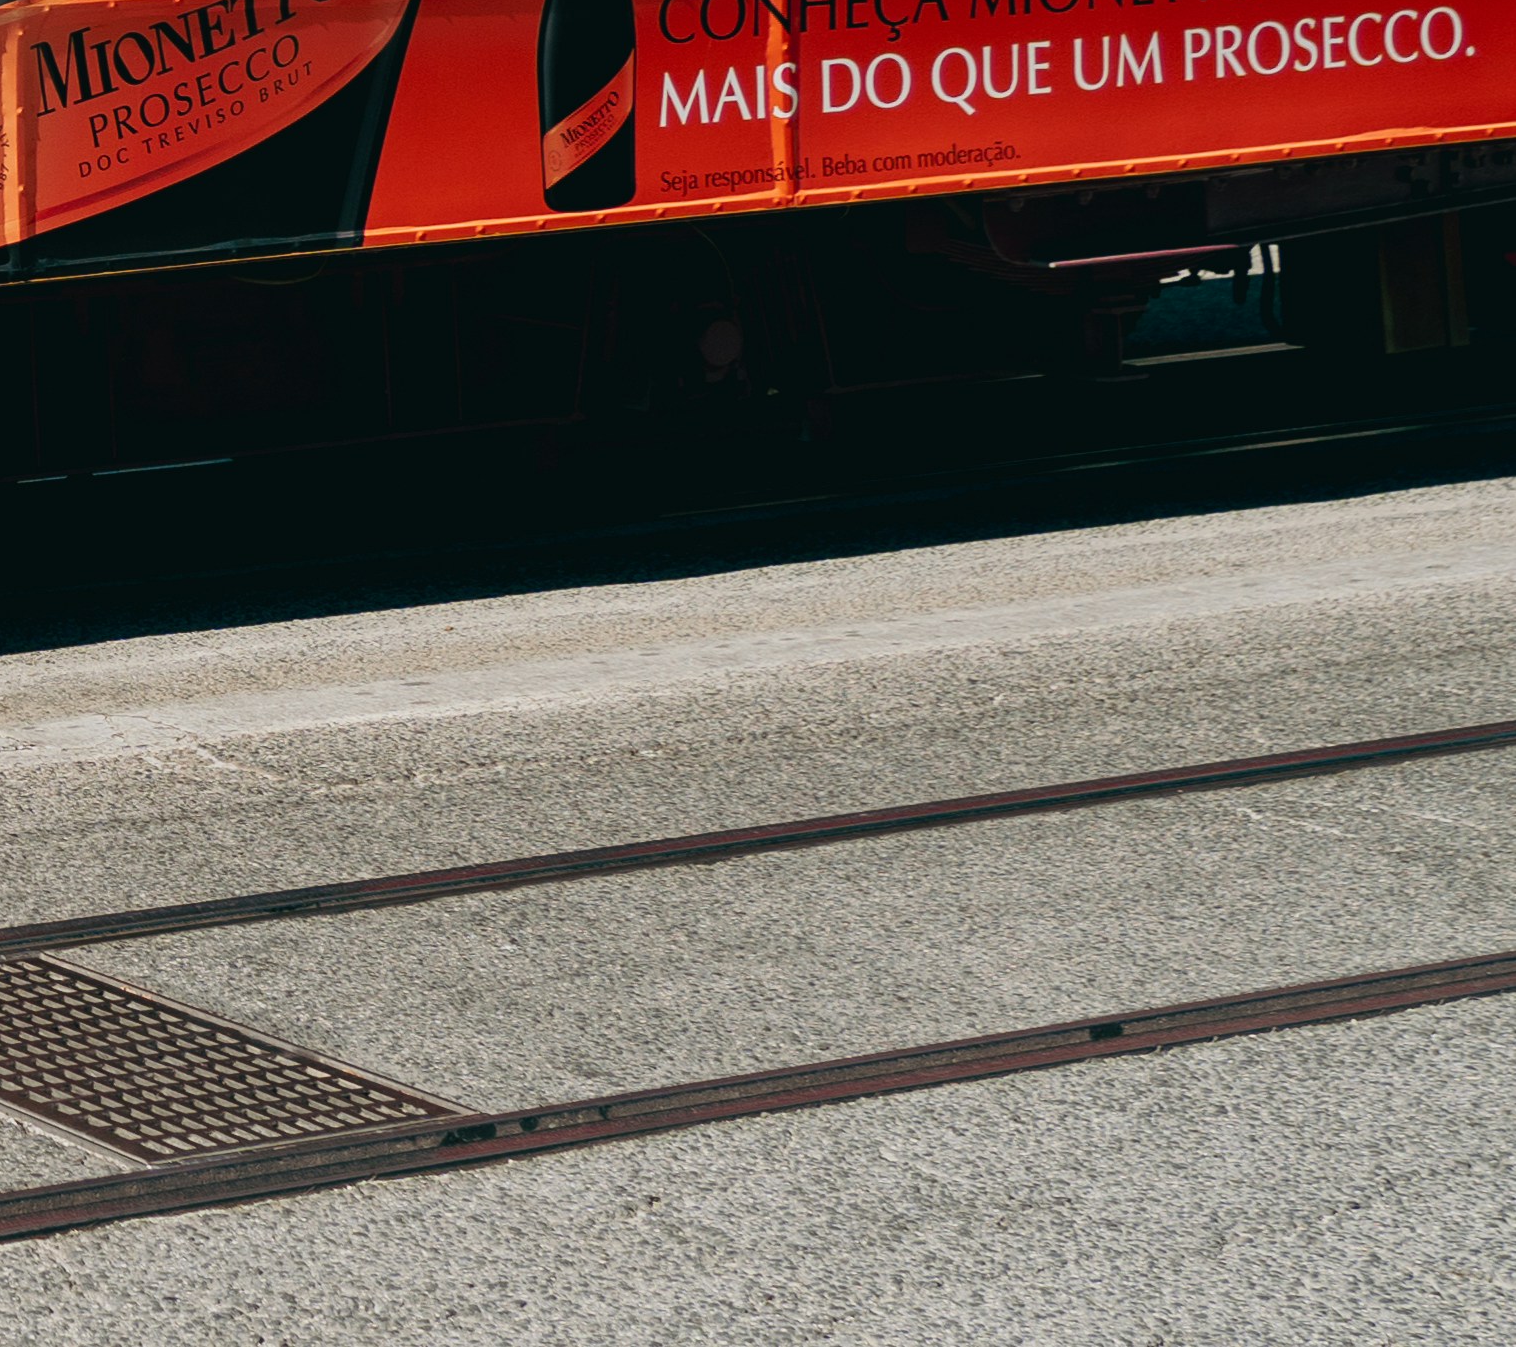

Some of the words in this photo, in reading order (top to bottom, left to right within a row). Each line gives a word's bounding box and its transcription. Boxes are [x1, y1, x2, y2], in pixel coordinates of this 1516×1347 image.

[78, 148, 130, 178] DOC
[142, 99, 245, 154] TREVISO
[258, 60, 314, 104] BRUT
[88, 34, 300, 148] PROSECCO
[658, 61, 799, 129] MAIS
[820, 52, 912, 115] DO
[930, 39, 1053, 116] QUE
[1073, 31, 1164, 91] UM
[1183, 5, 1476, 82] PROSECCO.
[660, 170, 699, 197] Seja
[704, 160, 816, 194] responsável.
[822, 154, 867, 177] Beba
[872, 154, 913, 173] com
[918, 140, 1022, 168] moderação.
